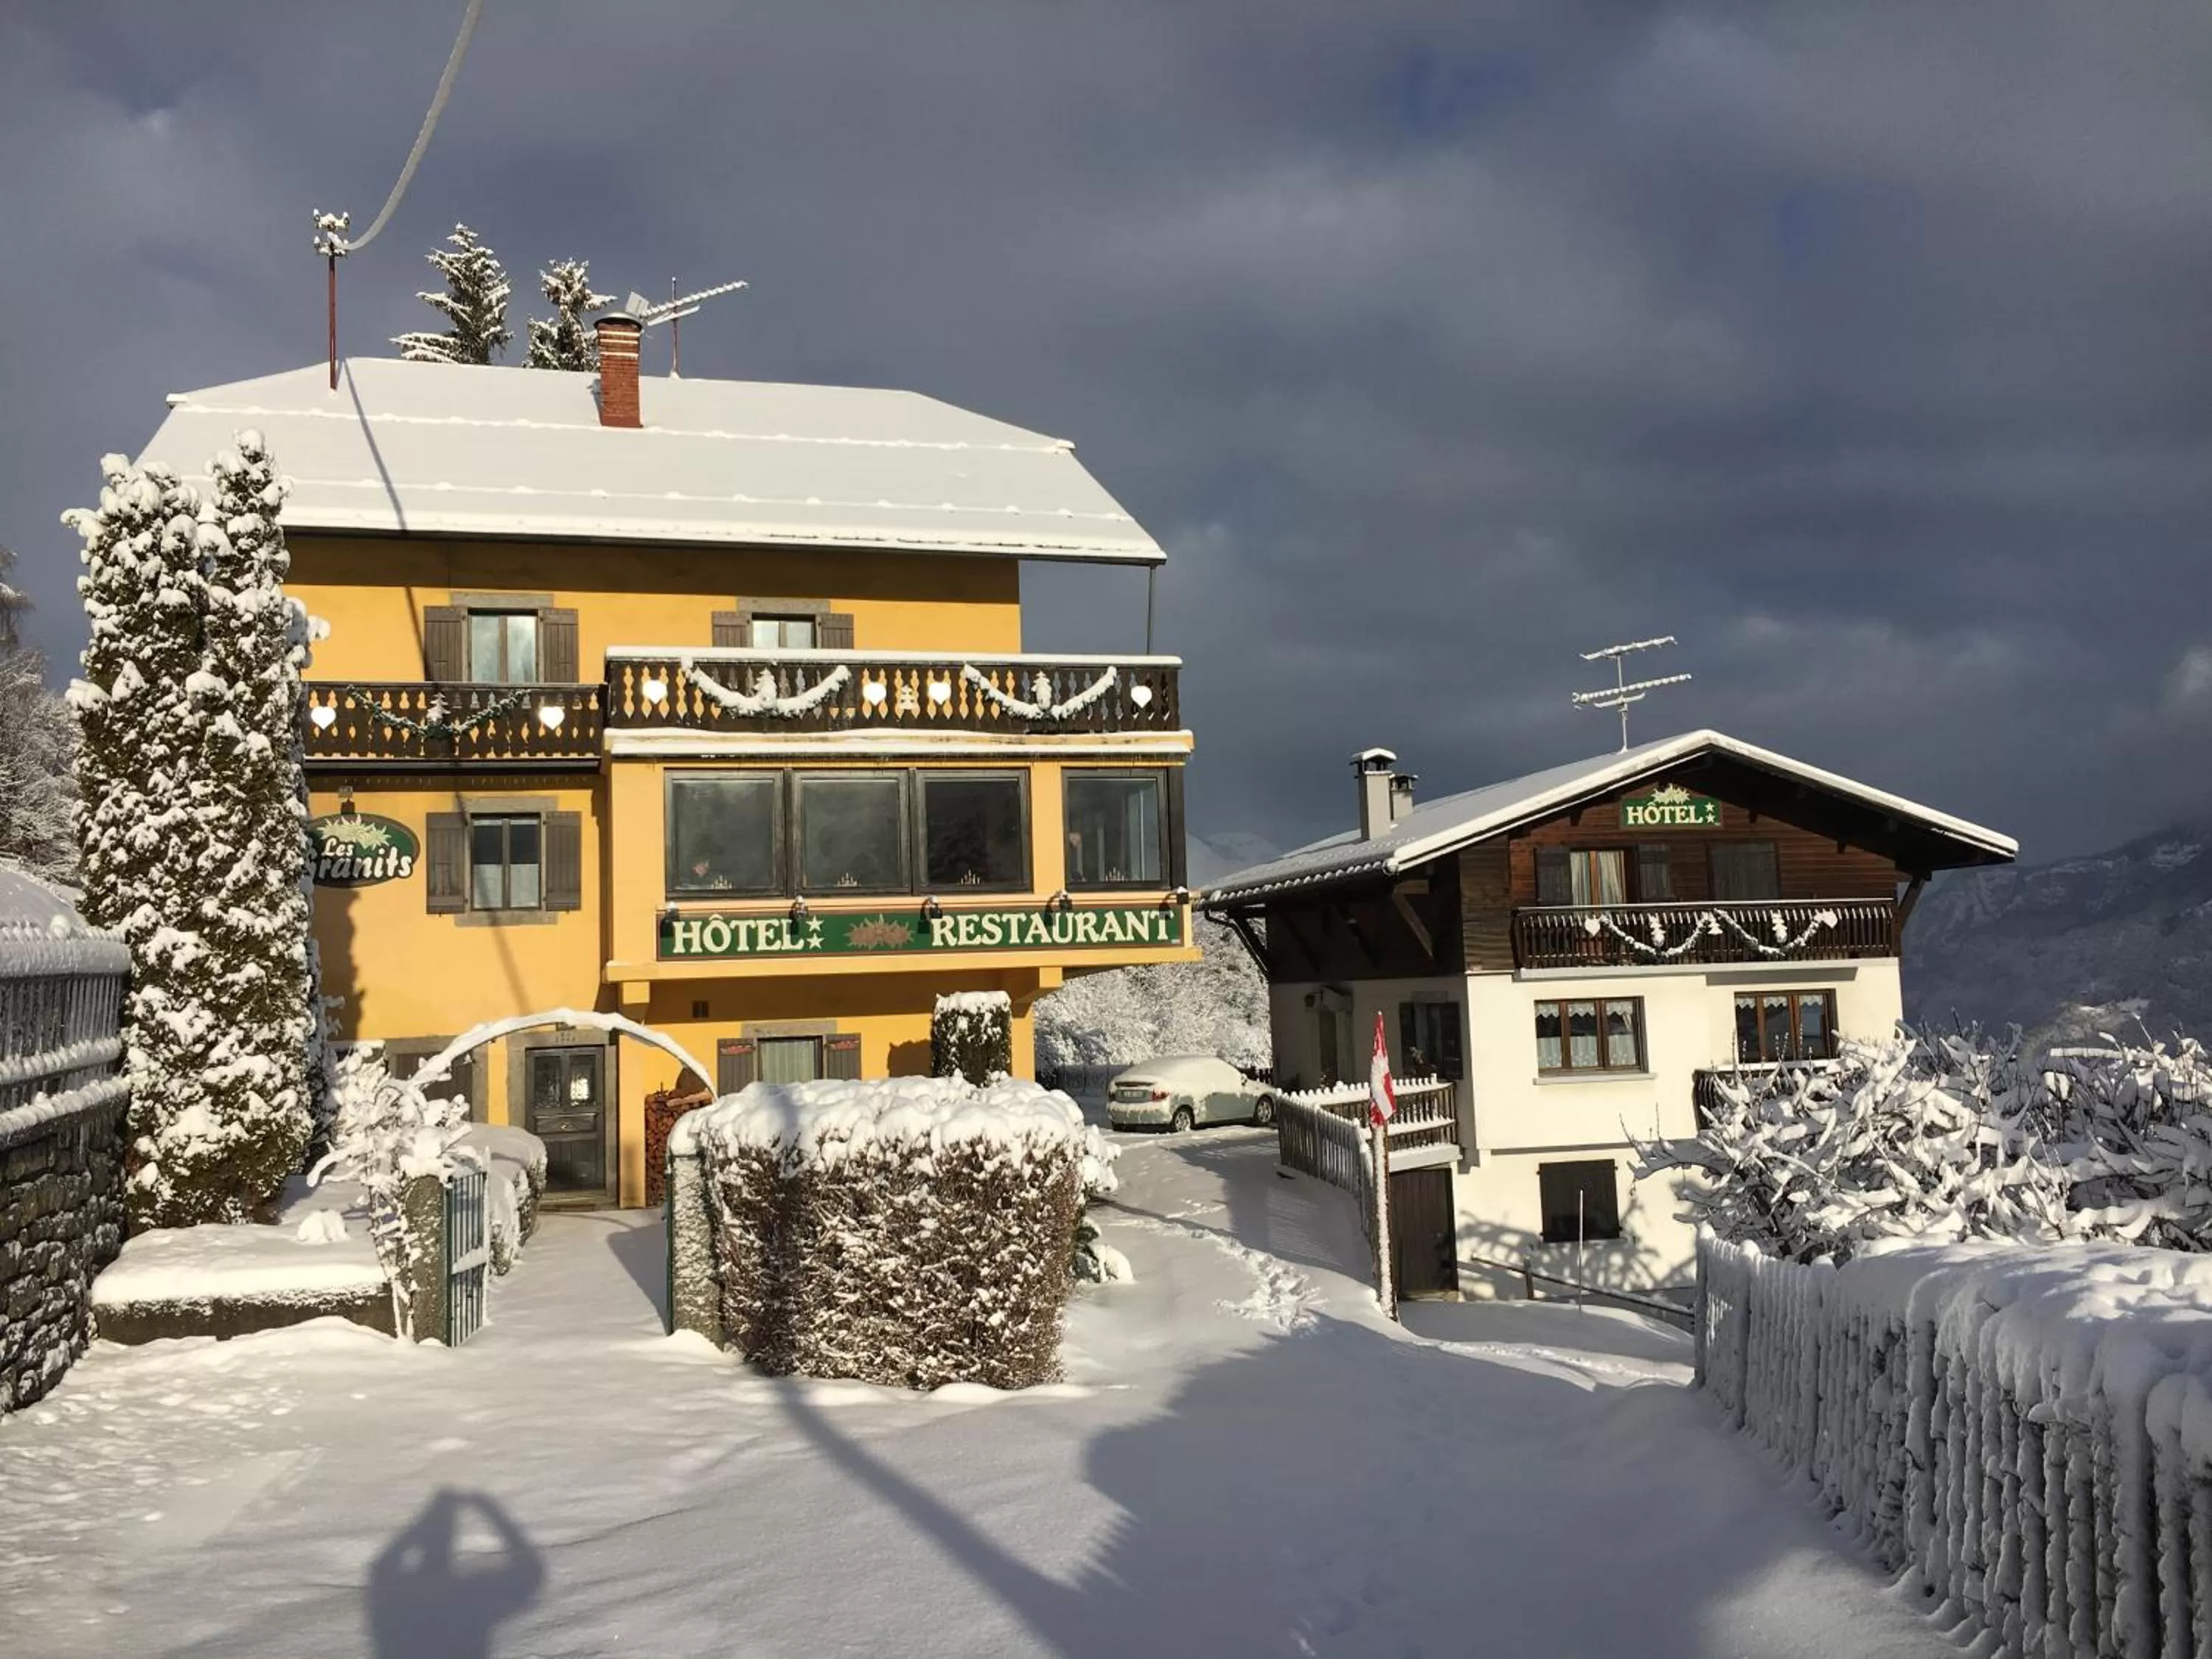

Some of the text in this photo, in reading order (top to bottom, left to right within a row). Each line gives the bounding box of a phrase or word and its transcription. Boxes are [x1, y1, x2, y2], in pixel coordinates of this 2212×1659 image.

[1626, 801, 1703, 825] HÔTEL
[321, 837, 354, 856] Les
[672, 910, 1175, 953] HÔTEL RESTAURANT
